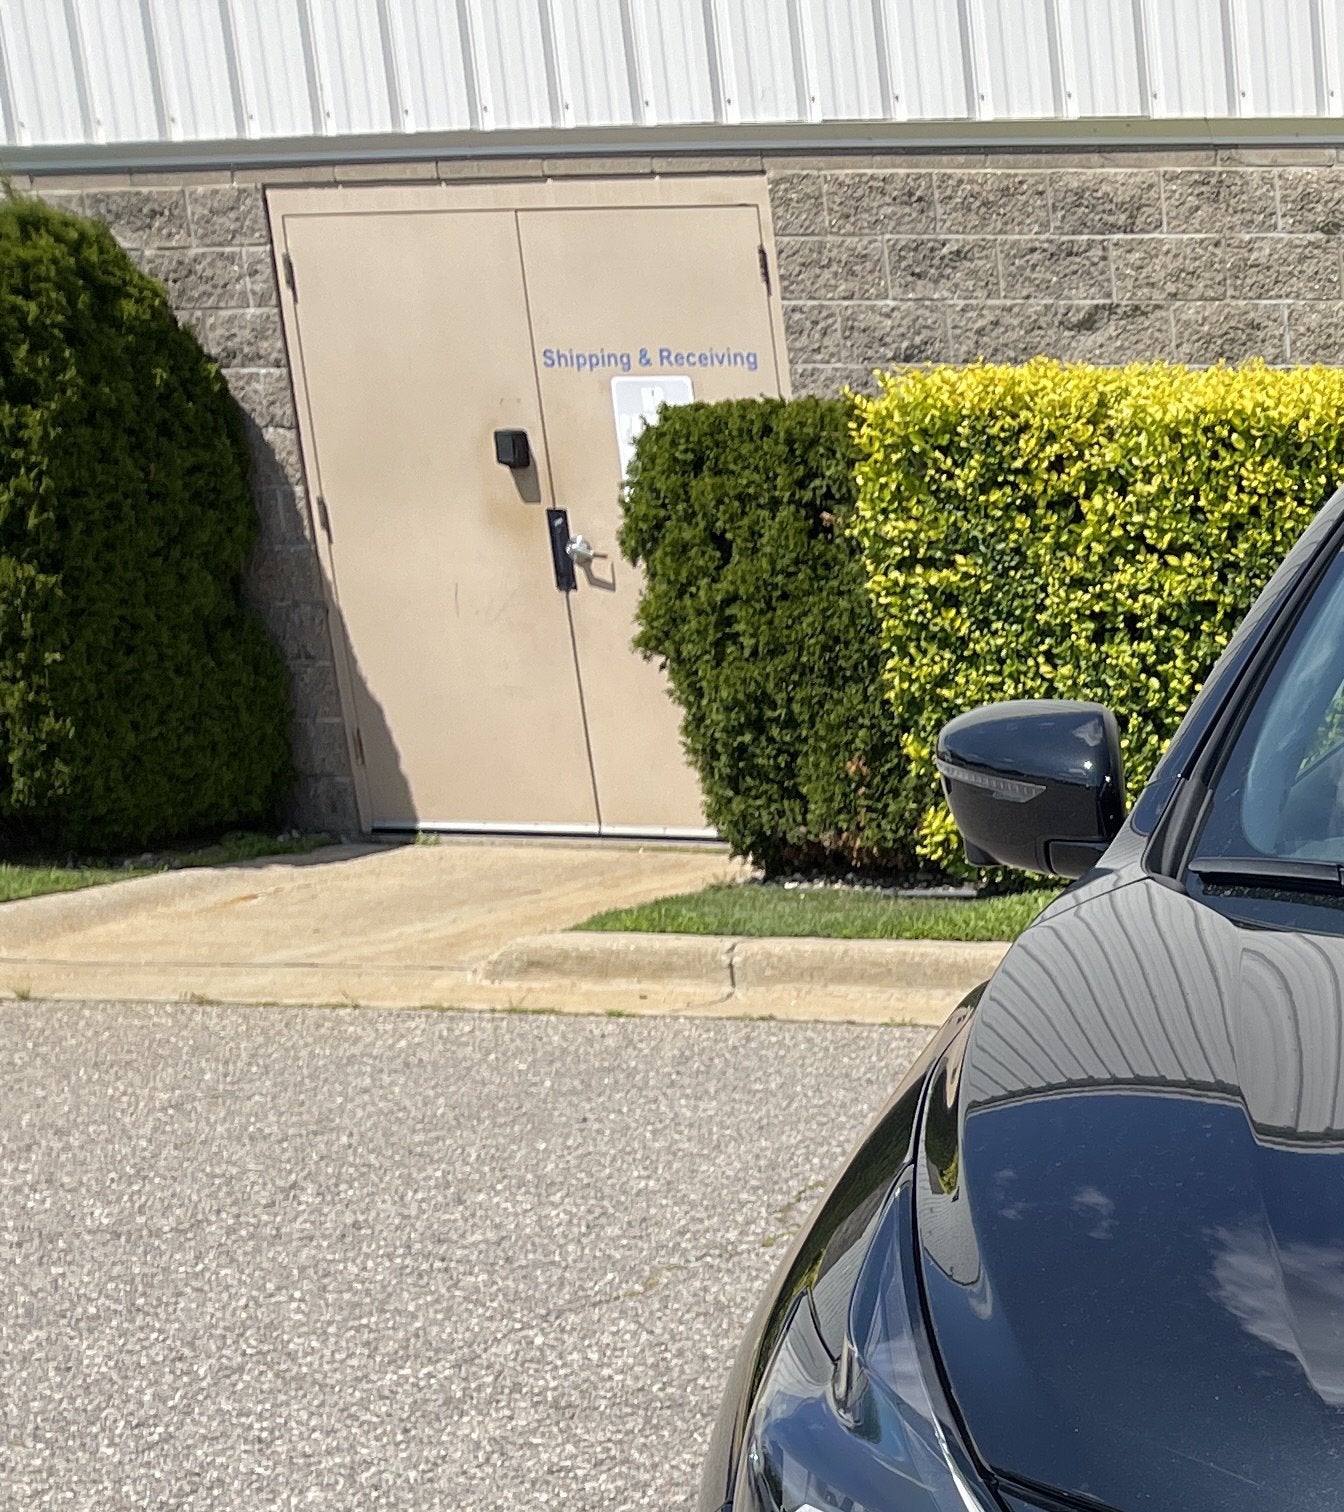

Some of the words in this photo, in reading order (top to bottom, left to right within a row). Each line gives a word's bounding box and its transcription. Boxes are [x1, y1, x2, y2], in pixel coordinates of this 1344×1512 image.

[542, 348, 631, 372] Shipping
[638, 347, 652, 367] &
[659, 347, 758, 371] Receiving
